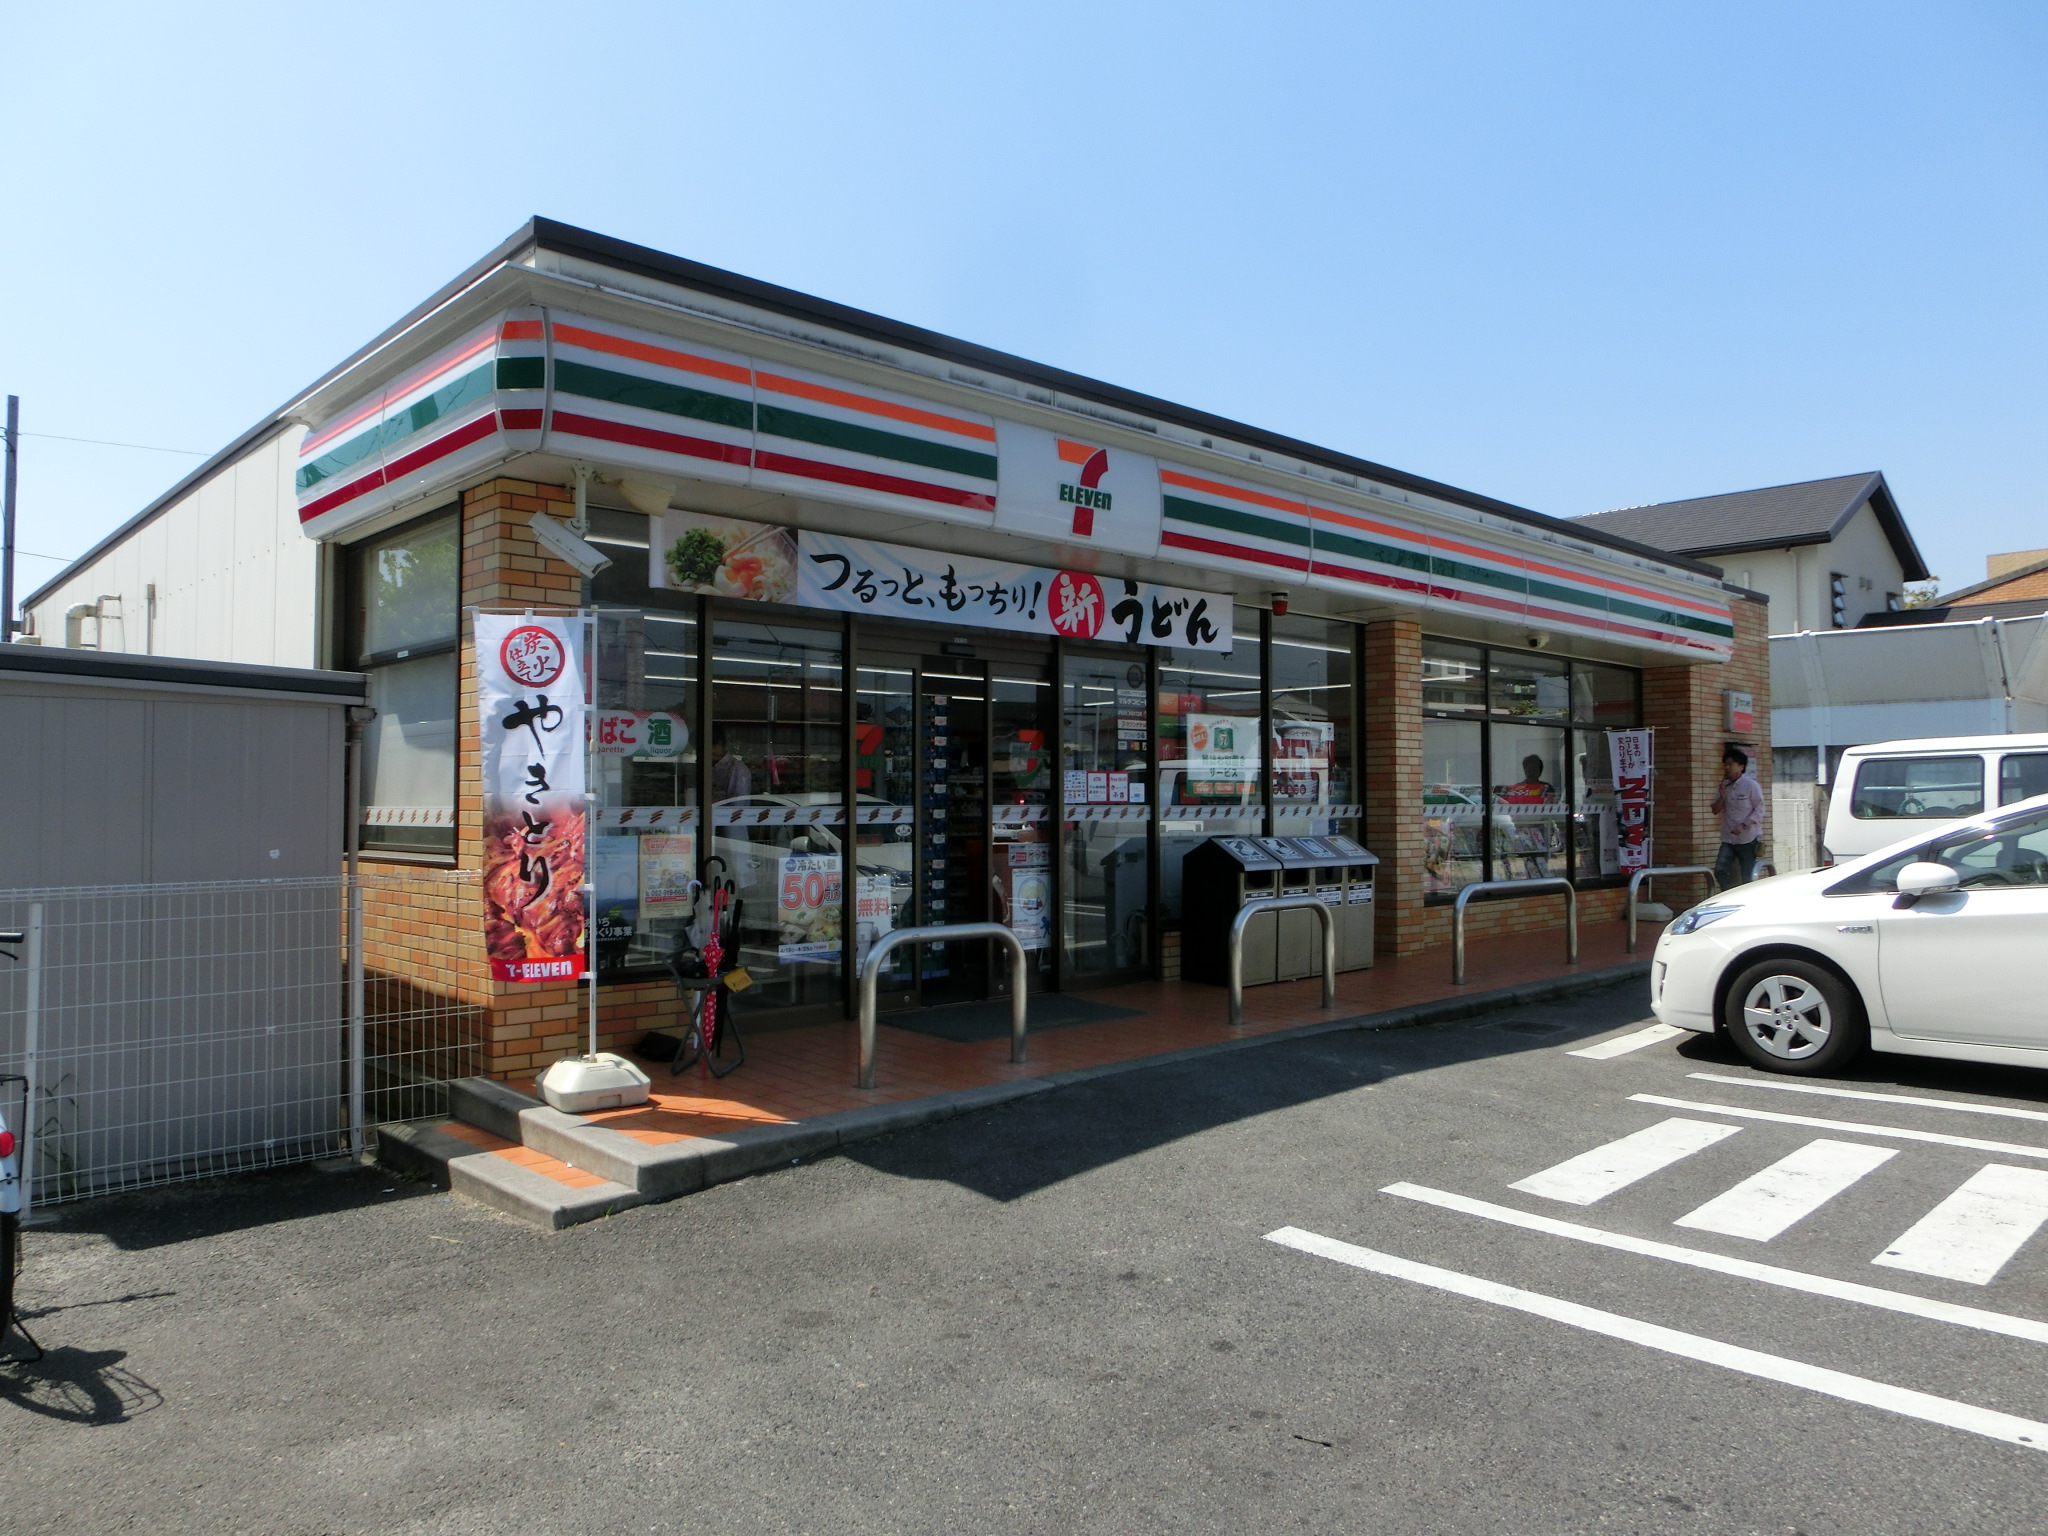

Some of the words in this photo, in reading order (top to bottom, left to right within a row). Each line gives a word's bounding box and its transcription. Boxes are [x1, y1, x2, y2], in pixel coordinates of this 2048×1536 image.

[1054, 573, 1100, 638] 新
[1111, 579, 1220, 646] うどん
[509, 647, 533, 681] 仕立て
[524, 632, 560, 678] 炭火
[647, 718, 672, 745] 酒
[1209, 768, 1238, 778] サービス
[502, 694, 563, 909] やきとり
[781, 871, 825, 910] 50
[857, 896, 891, 918] 無料
